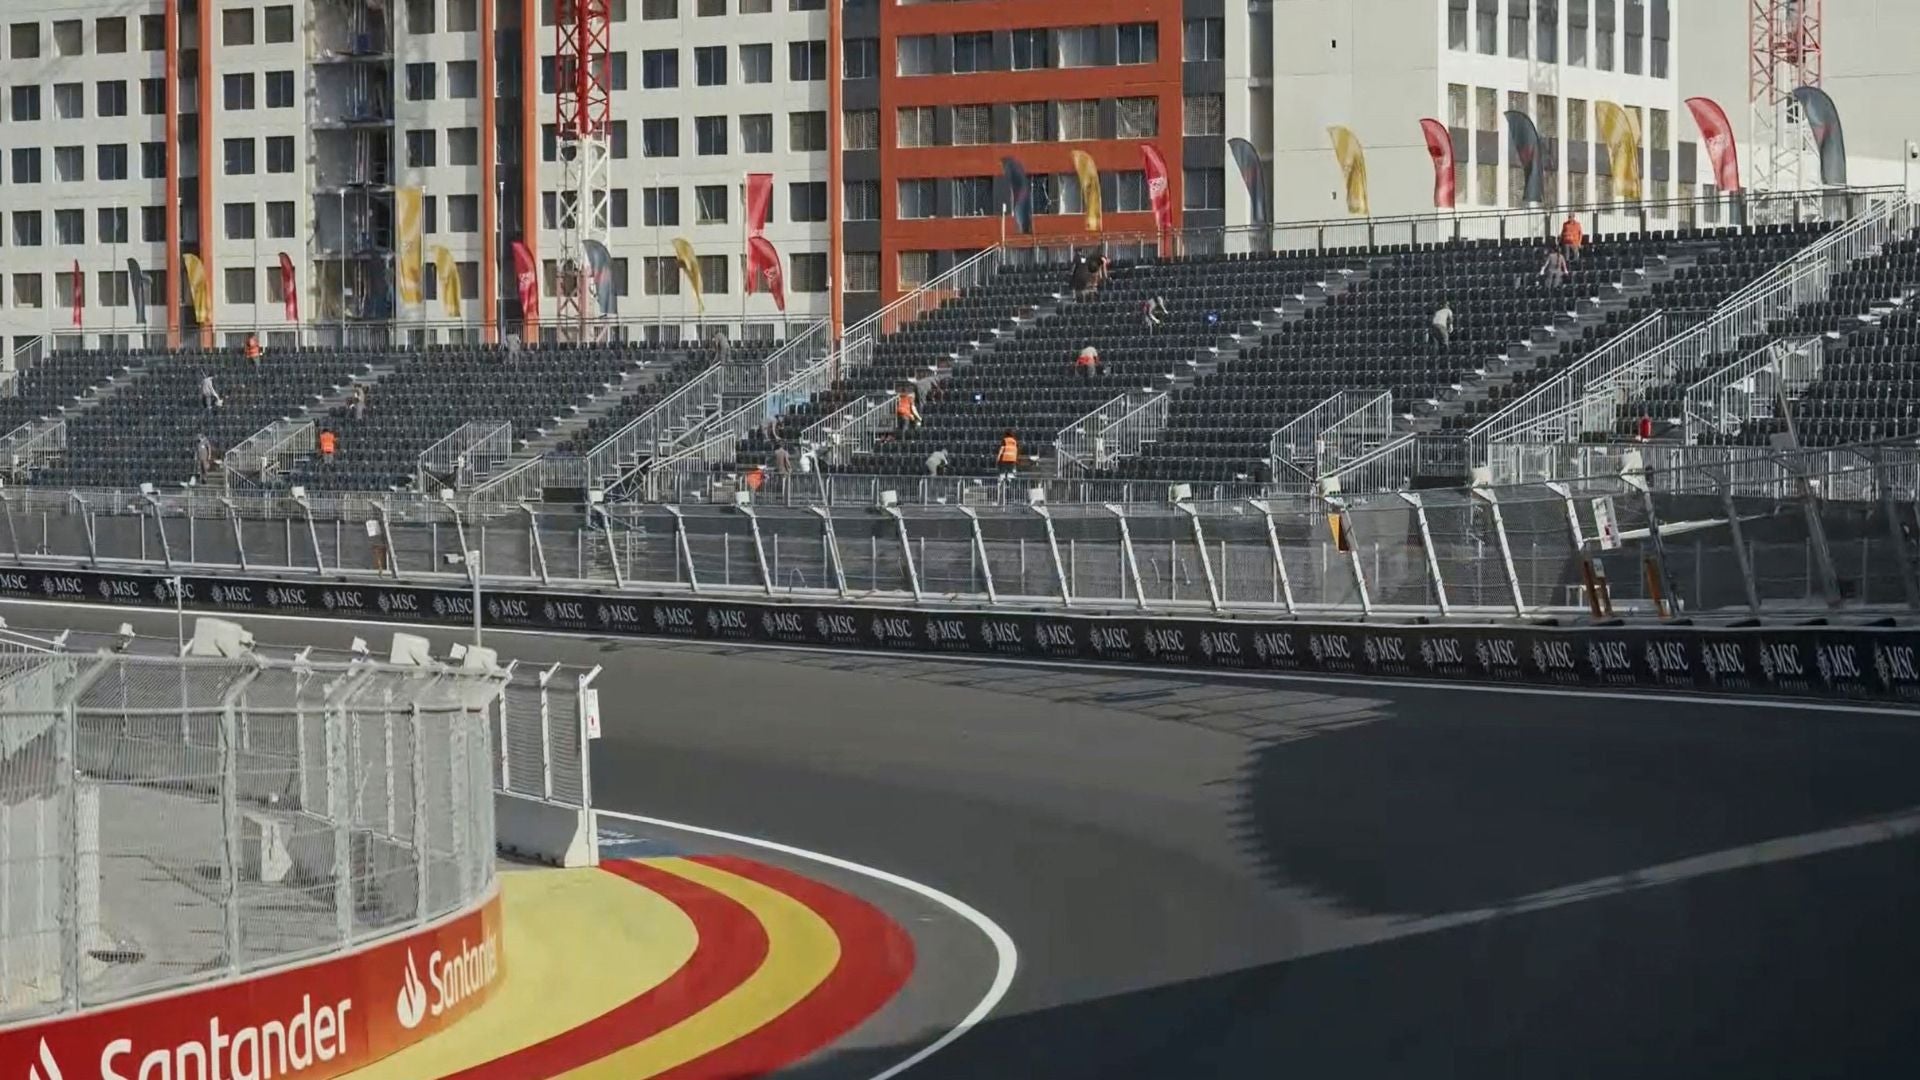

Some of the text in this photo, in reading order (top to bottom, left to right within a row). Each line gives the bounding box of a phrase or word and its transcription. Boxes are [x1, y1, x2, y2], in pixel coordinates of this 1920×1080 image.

[0, 574, 28, 590] MSC
[55, 577, 83, 593] MSC
[110, 580, 139, 596] MSC
[224, 586, 251, 601] MSC
[278, 588, 306, 604] MSC
[335, 590, 363, 607] MSC
[390, 594, 418, 610] MSC
[446, 596, 473, 614] MSC
[500, 599, 528, 616] MSC
[556, 602, 584, 620] MSC
[610, 605, 638, 622] MSC
[666, 606, 693, 625] MSC
[719, 610, 747, 628] MSC
[774, 612, 802, 632] MSC
[828, 614, 856, 634] MSC
[884, 618, 912, 638] MSC
[937, 620, 966, 639] MSC
[992, 622, 1021, 642] MSC
[1047, 625, 1076, 645] MSC
[1102, 627, 1130, 648] MSC
[1156, 629, 1185, 650] MSC
[1212, 632, 1240, 654] MSC
[1265, 633, 1294, 655] MSC
[1321, 634, 1350, 658] MSC
[1376, 636, 1405, 660] MSC
[1432, 638, 1462, 663] MSC
[1488, 639, 1518, 665] MSC
[1544, 641, 1574, 668] MSC
[1600, 641, 1630, 669] MSC
[1656, 642, 1688, 670] MSC
[1713, 643, 1744, 672] MSC
[1770, 644, 1803, 674] MSC
[1828, 645, 1860, 677] MSC
[1885, 646, 1919, 679] MSC
[100, 993, 352, 1080] Santander
